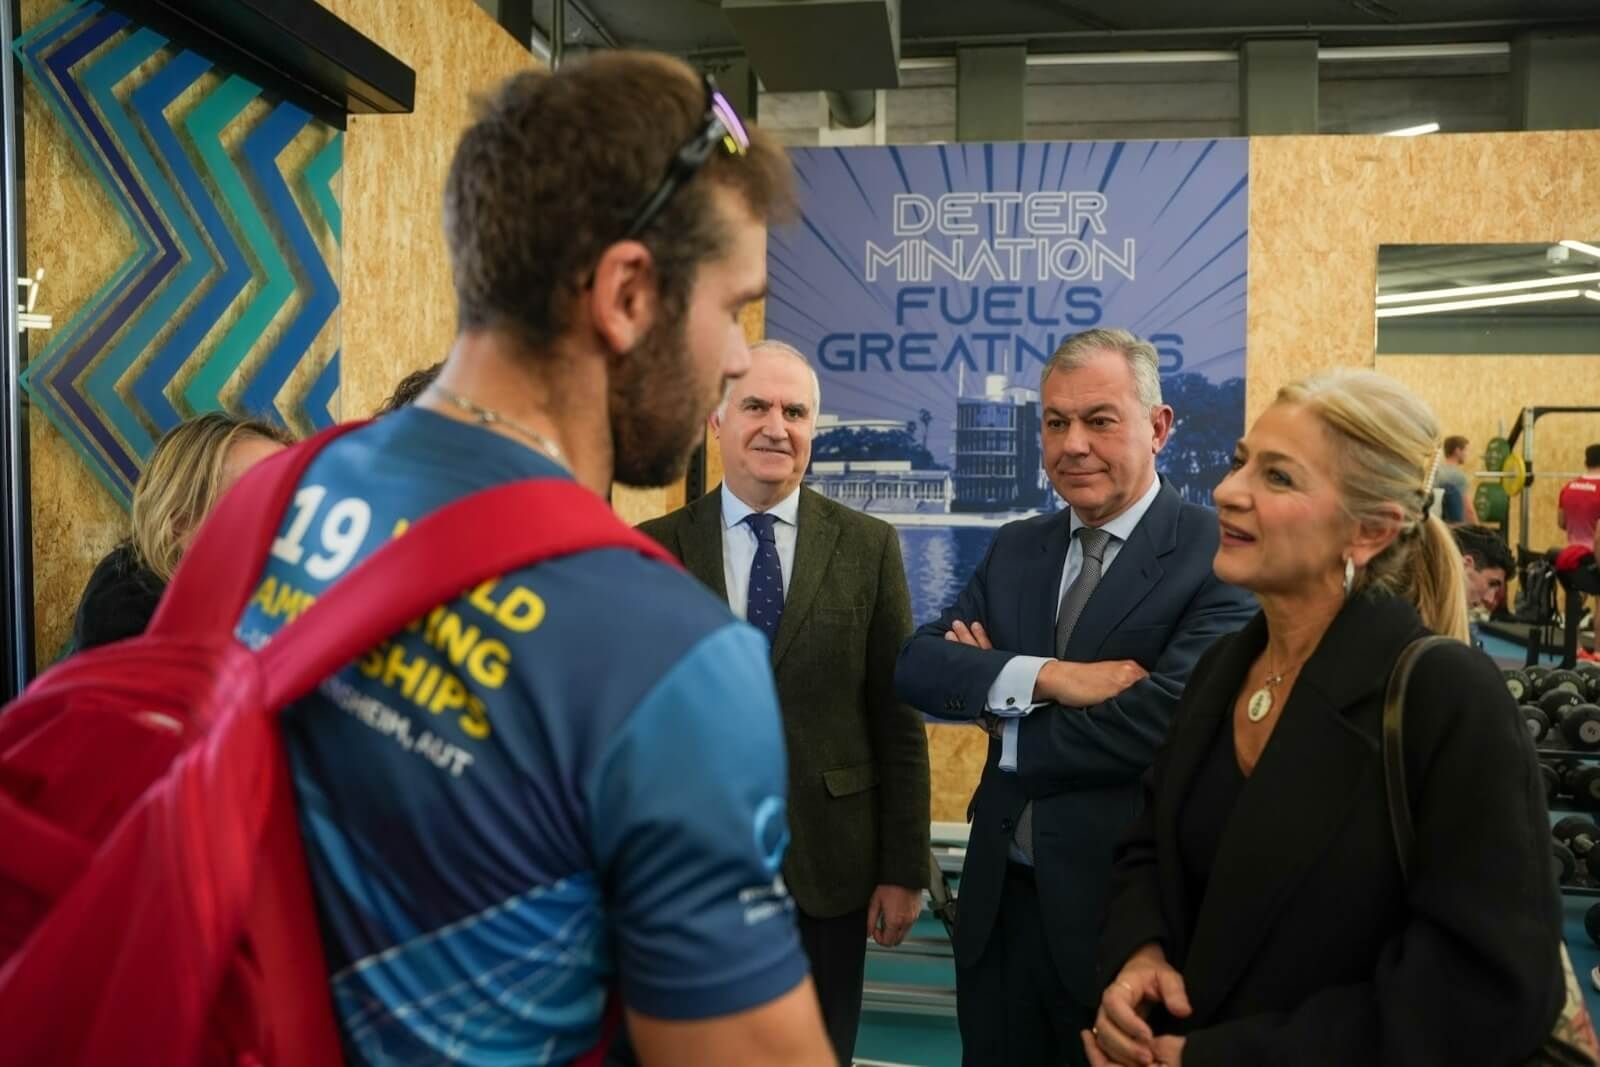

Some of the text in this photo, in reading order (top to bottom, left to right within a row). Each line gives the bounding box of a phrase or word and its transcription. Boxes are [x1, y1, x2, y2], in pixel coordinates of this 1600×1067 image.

[893, 191, 1108, 236] DETER
[865, 238, 1136, 283] MINATION
[896, 287, 1103, 327] FUELS
[817, 332, 1185, 373] GREATNS
